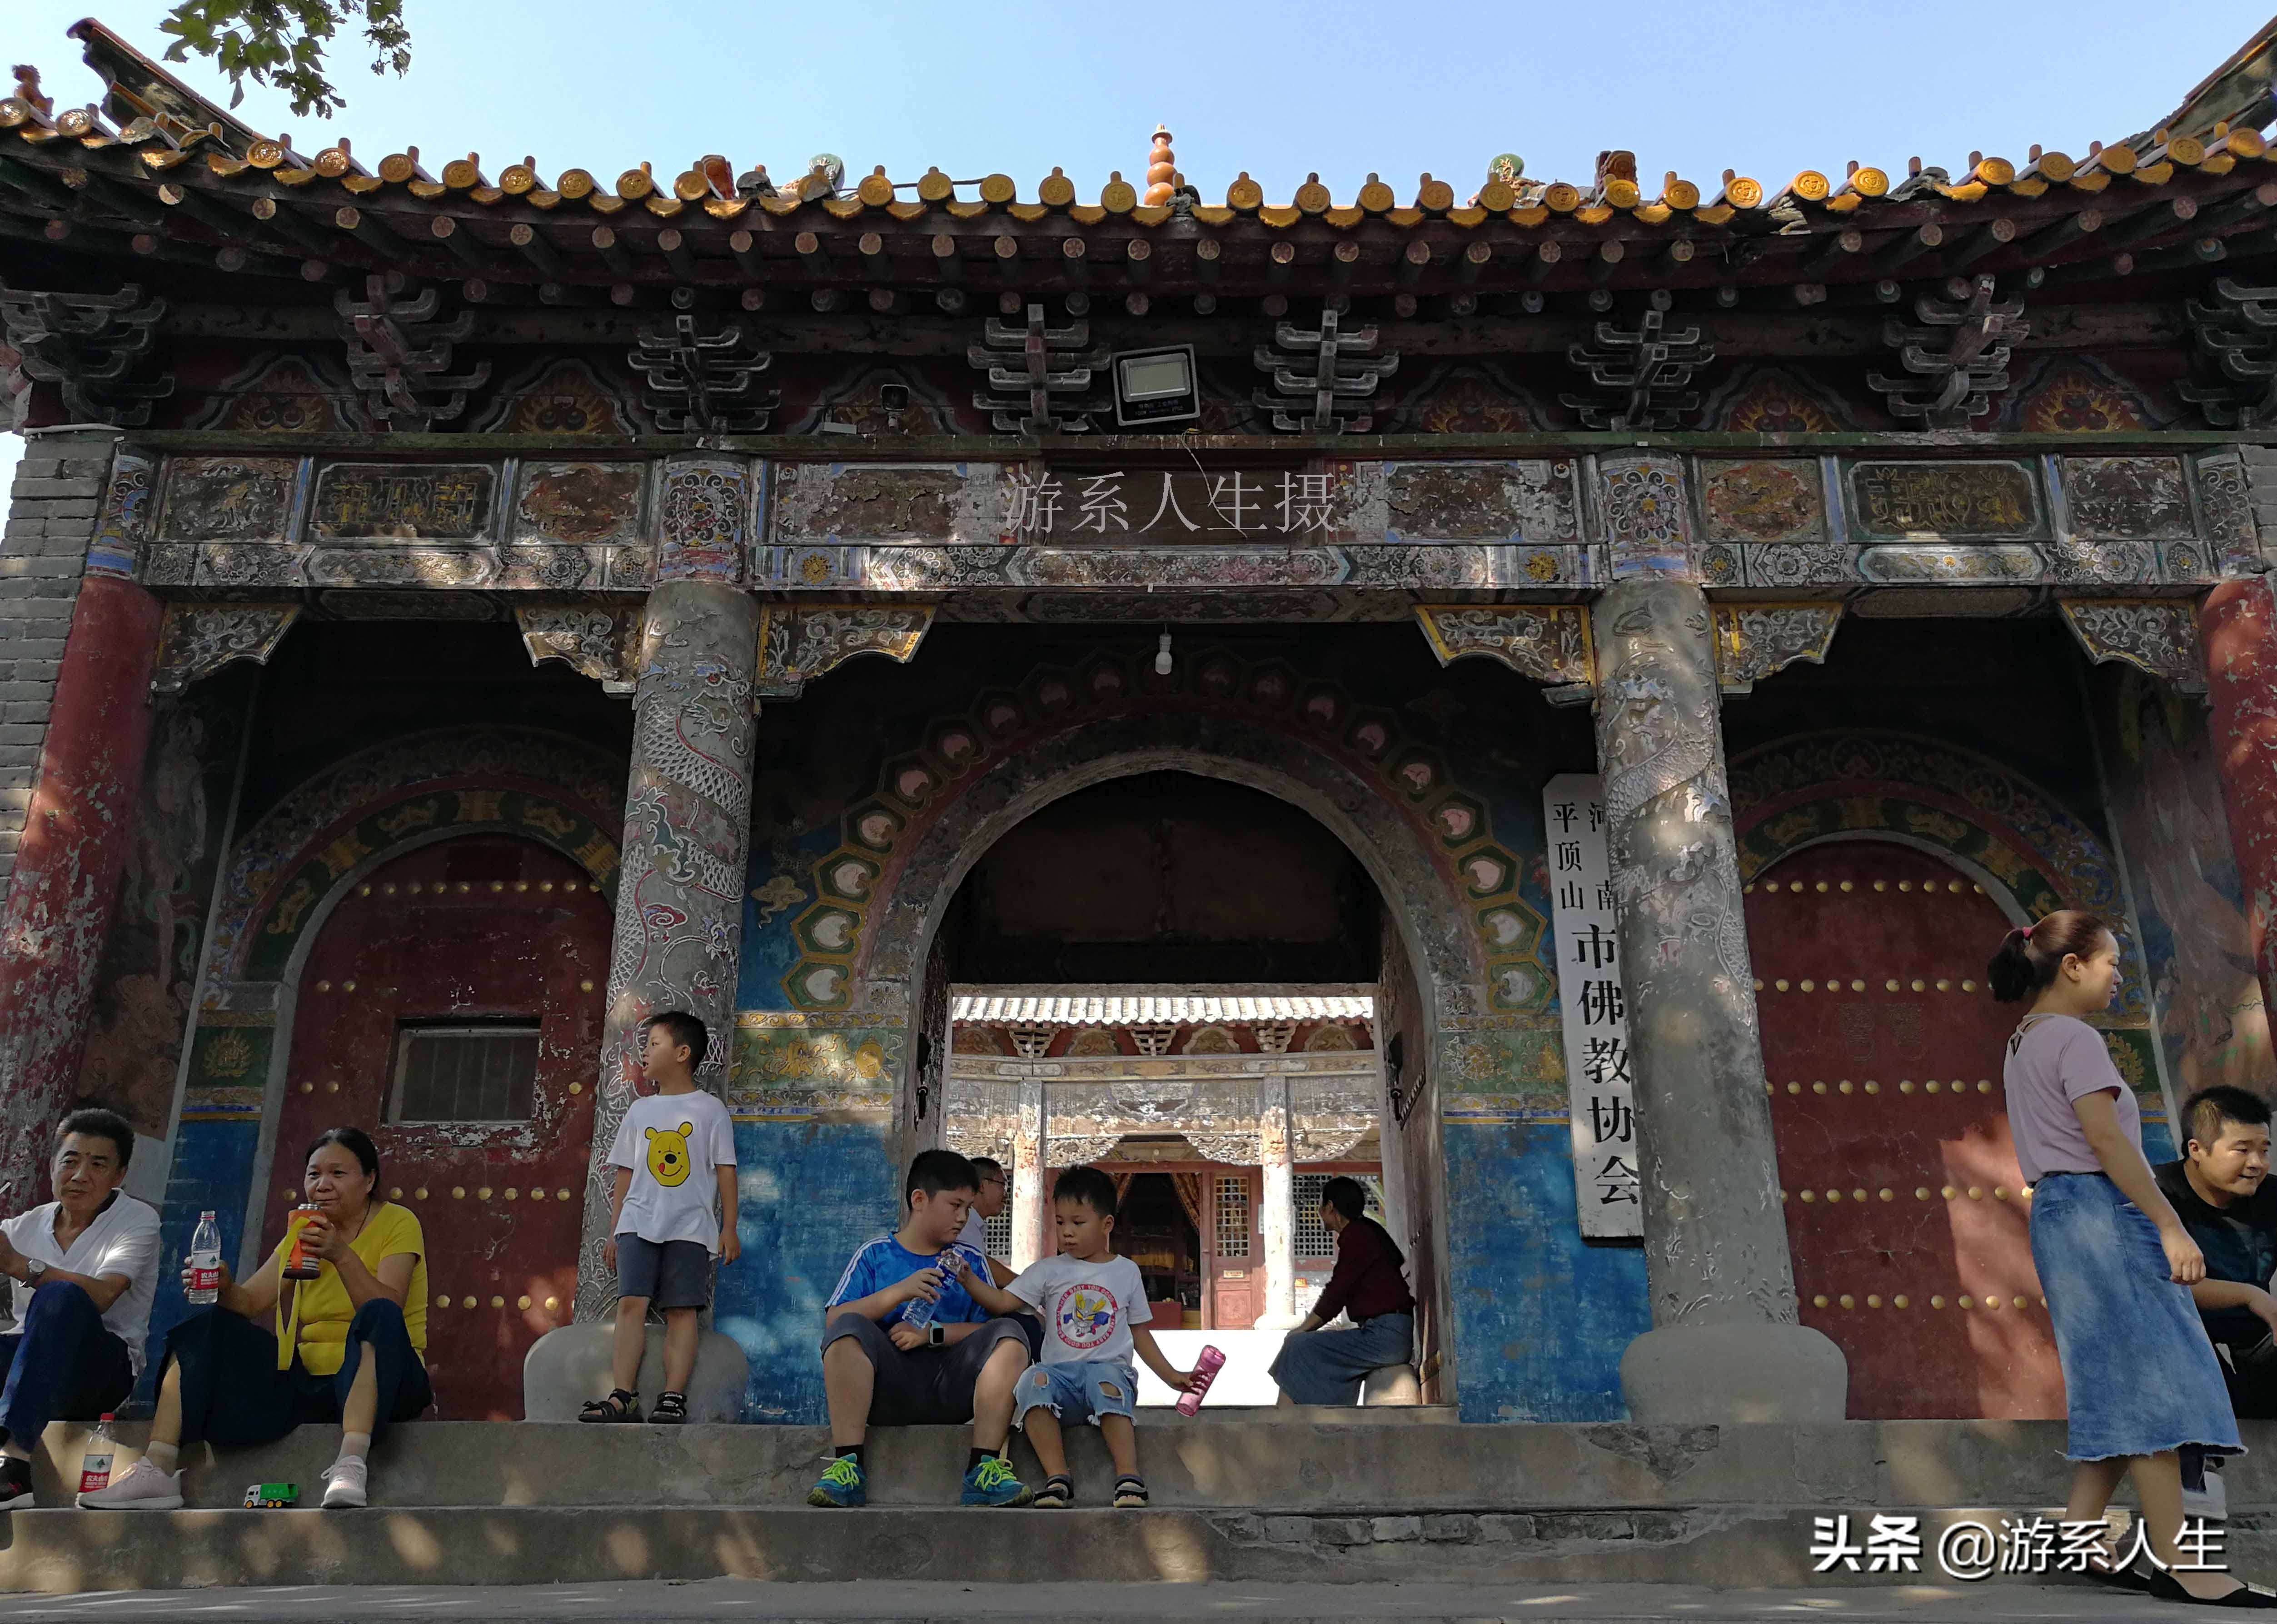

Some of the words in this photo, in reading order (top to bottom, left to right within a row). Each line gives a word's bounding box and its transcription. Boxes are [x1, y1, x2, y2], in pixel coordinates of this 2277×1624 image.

[1552, 801, 1584, 910] 平顶山
[1571, 923, 1640, 1205] 市佛教协会
